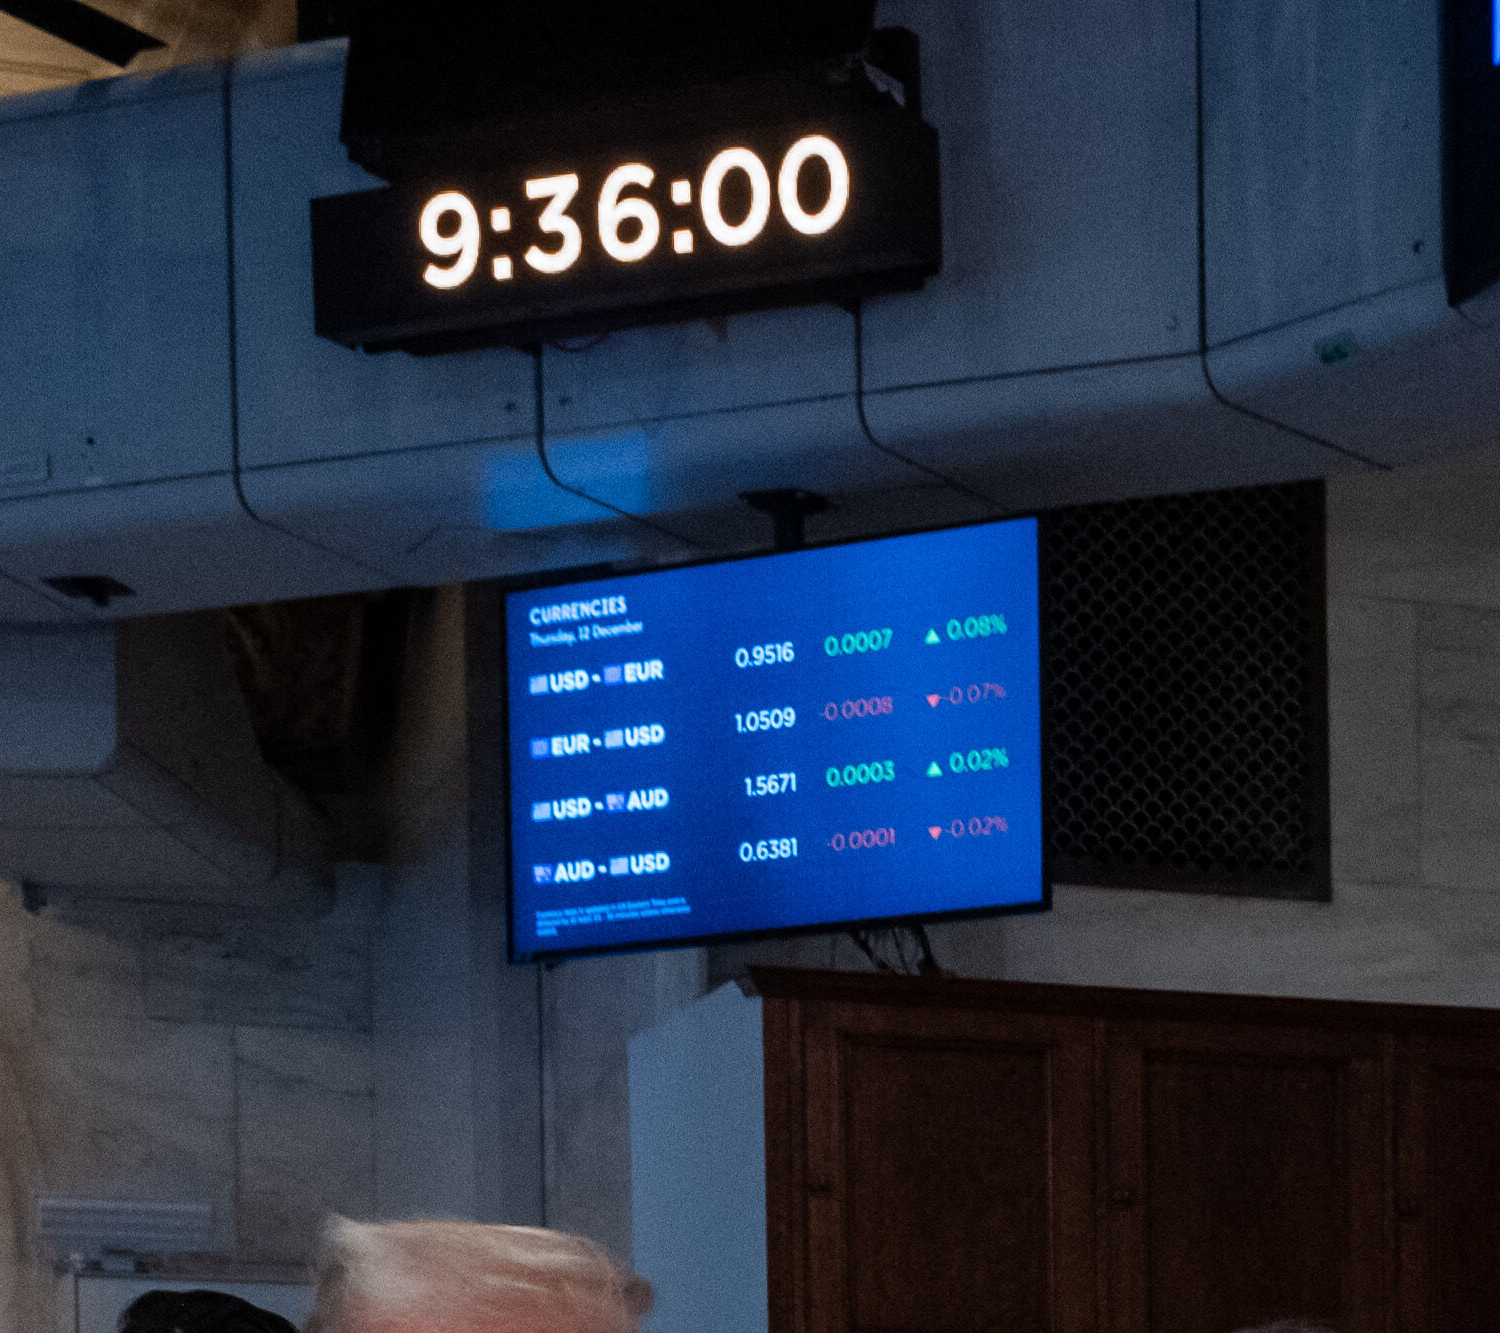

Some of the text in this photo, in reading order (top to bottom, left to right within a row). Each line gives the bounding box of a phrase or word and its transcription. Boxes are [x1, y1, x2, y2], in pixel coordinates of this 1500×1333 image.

[419, 135, 849, 290] 9:36:00
[529, 594, 628, 627] CURRENCIES
[578, 625, 590, 641] 12
[592, 619, 644, 639] December
[549, 614, 1007, 694] USD EUR 0.9516 0.0007 0.08%
[550, 733, 591, 758] EUR
[624, 722, 666, 748] USD
[734, 707, 796, 733] 1.0509
[551, 748, 1009, 821] USD AUD 1.5671 0.0003 0.02%
[554, 859, 596, 884] AUD
[630, 851, 670, 876] USD
[739, 838, 798, 862] 0.6381
